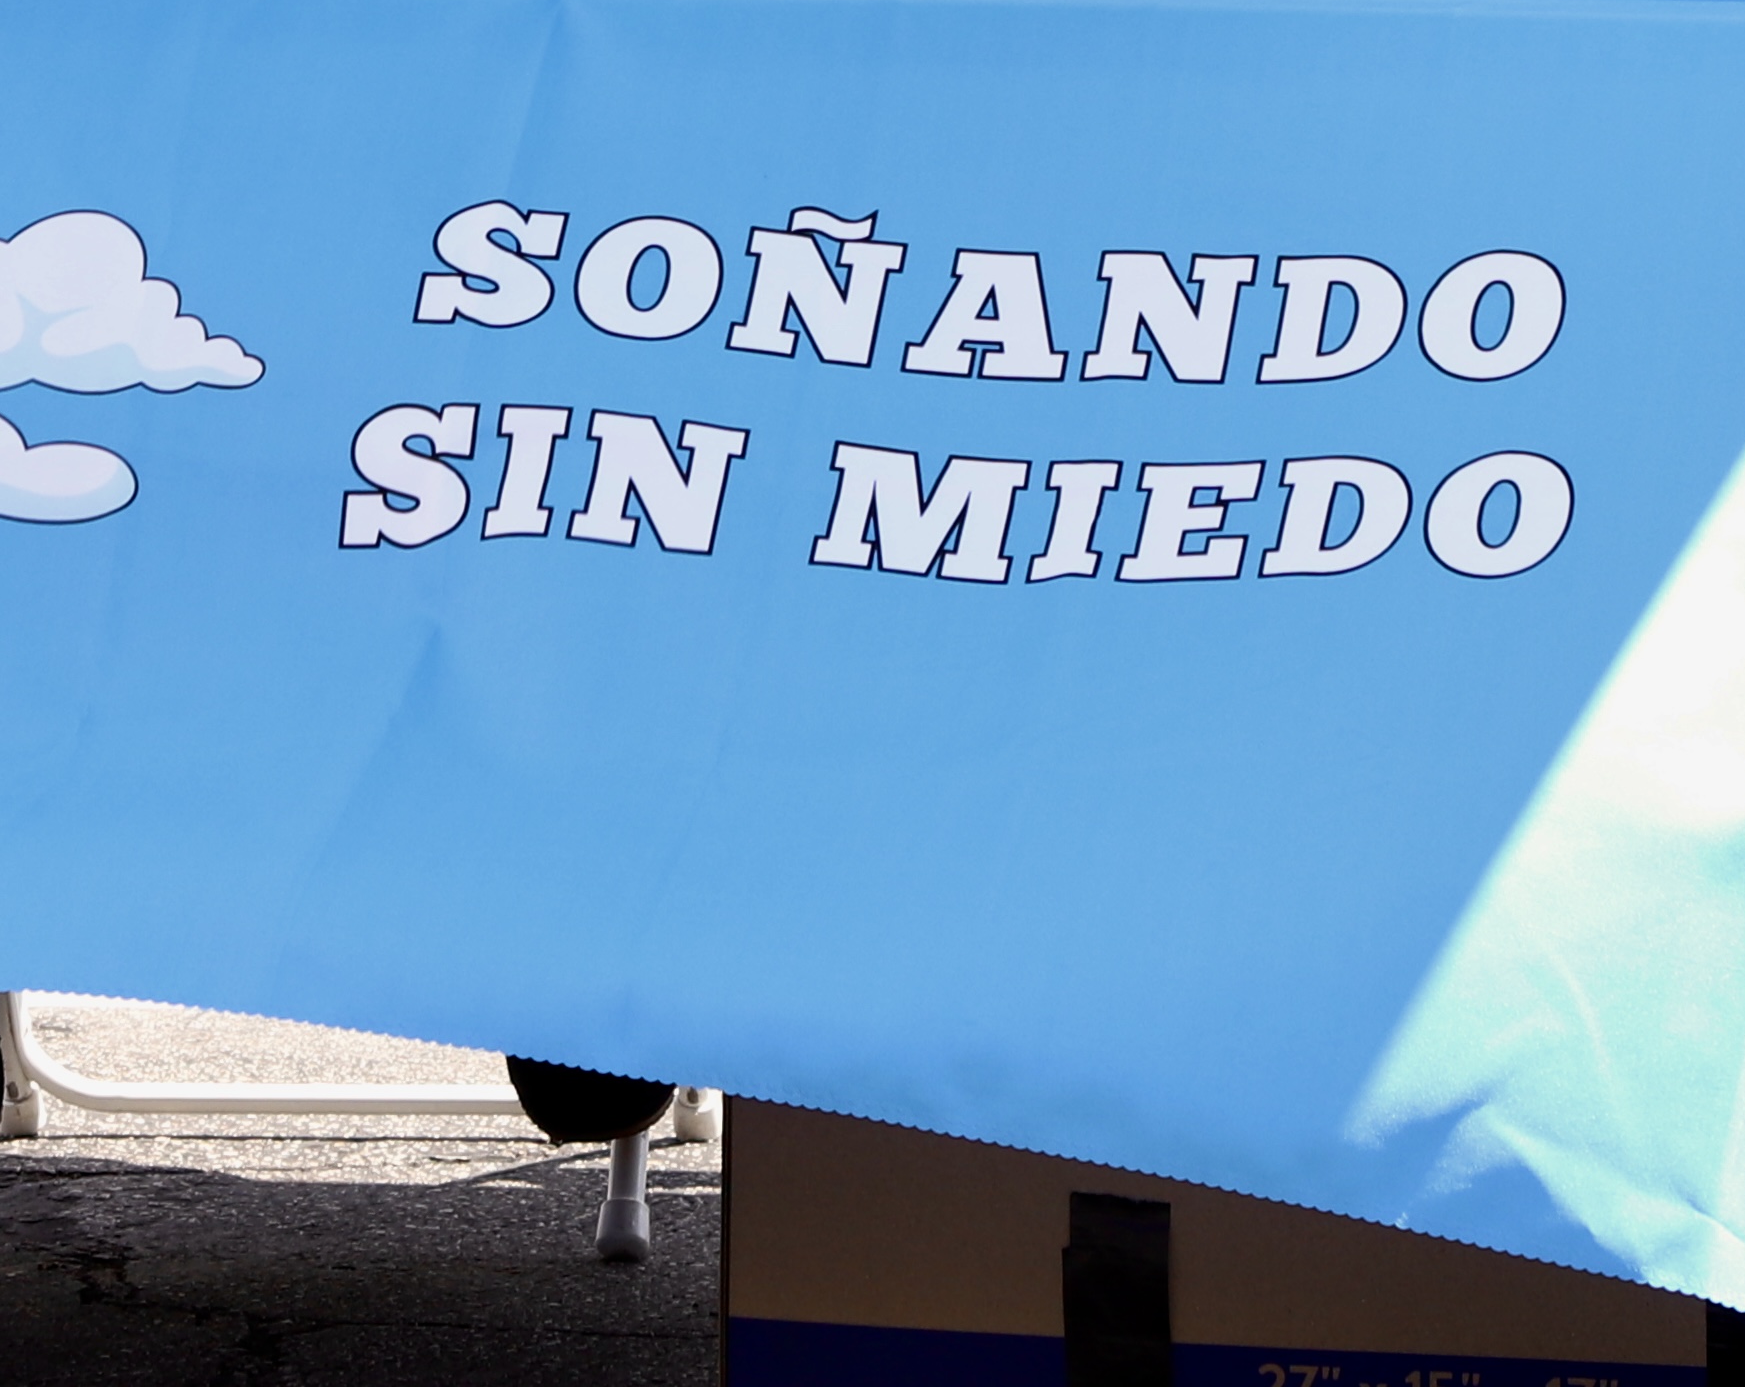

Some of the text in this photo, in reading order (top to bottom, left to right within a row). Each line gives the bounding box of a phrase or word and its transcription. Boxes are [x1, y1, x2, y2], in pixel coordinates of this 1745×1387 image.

[413, 199, 1567, 384] SOÑANDO
[338, 401, 1576, 585] SIN MIEDO
